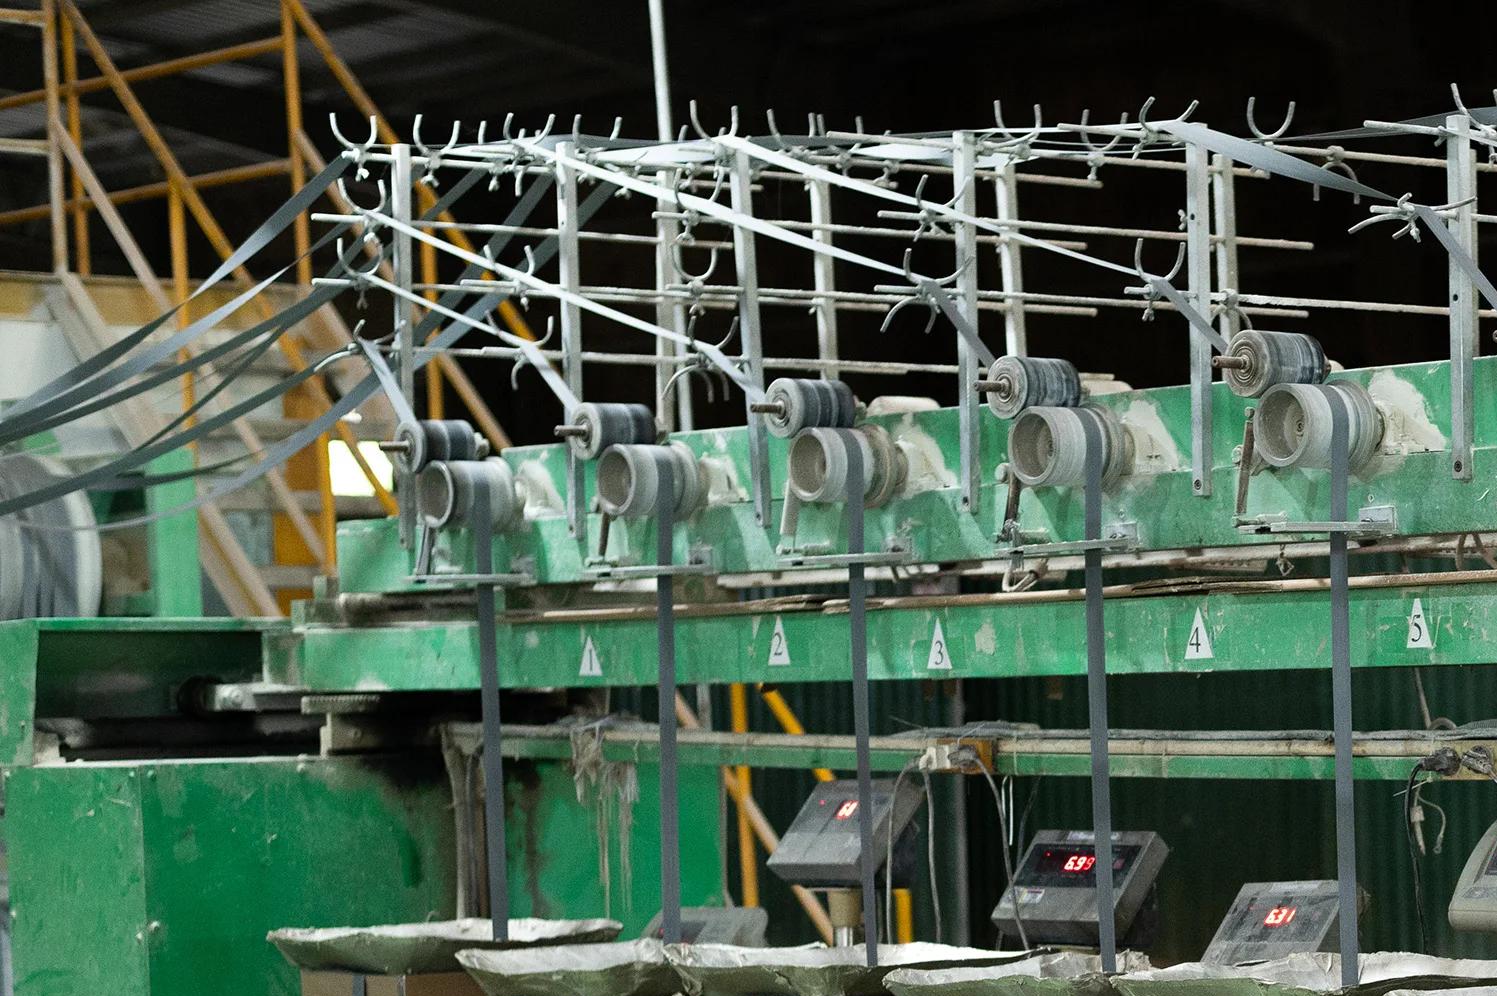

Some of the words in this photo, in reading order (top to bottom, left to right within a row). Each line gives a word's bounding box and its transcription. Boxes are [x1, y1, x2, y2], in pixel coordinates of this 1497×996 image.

[1189, 627, 1201, 653] 4
[1411, 614, 1422, 642] 5
[773, 633, 784, 657] 2
[935, 640, 944, 666] 3
[588, 649, 594, 673] 1
